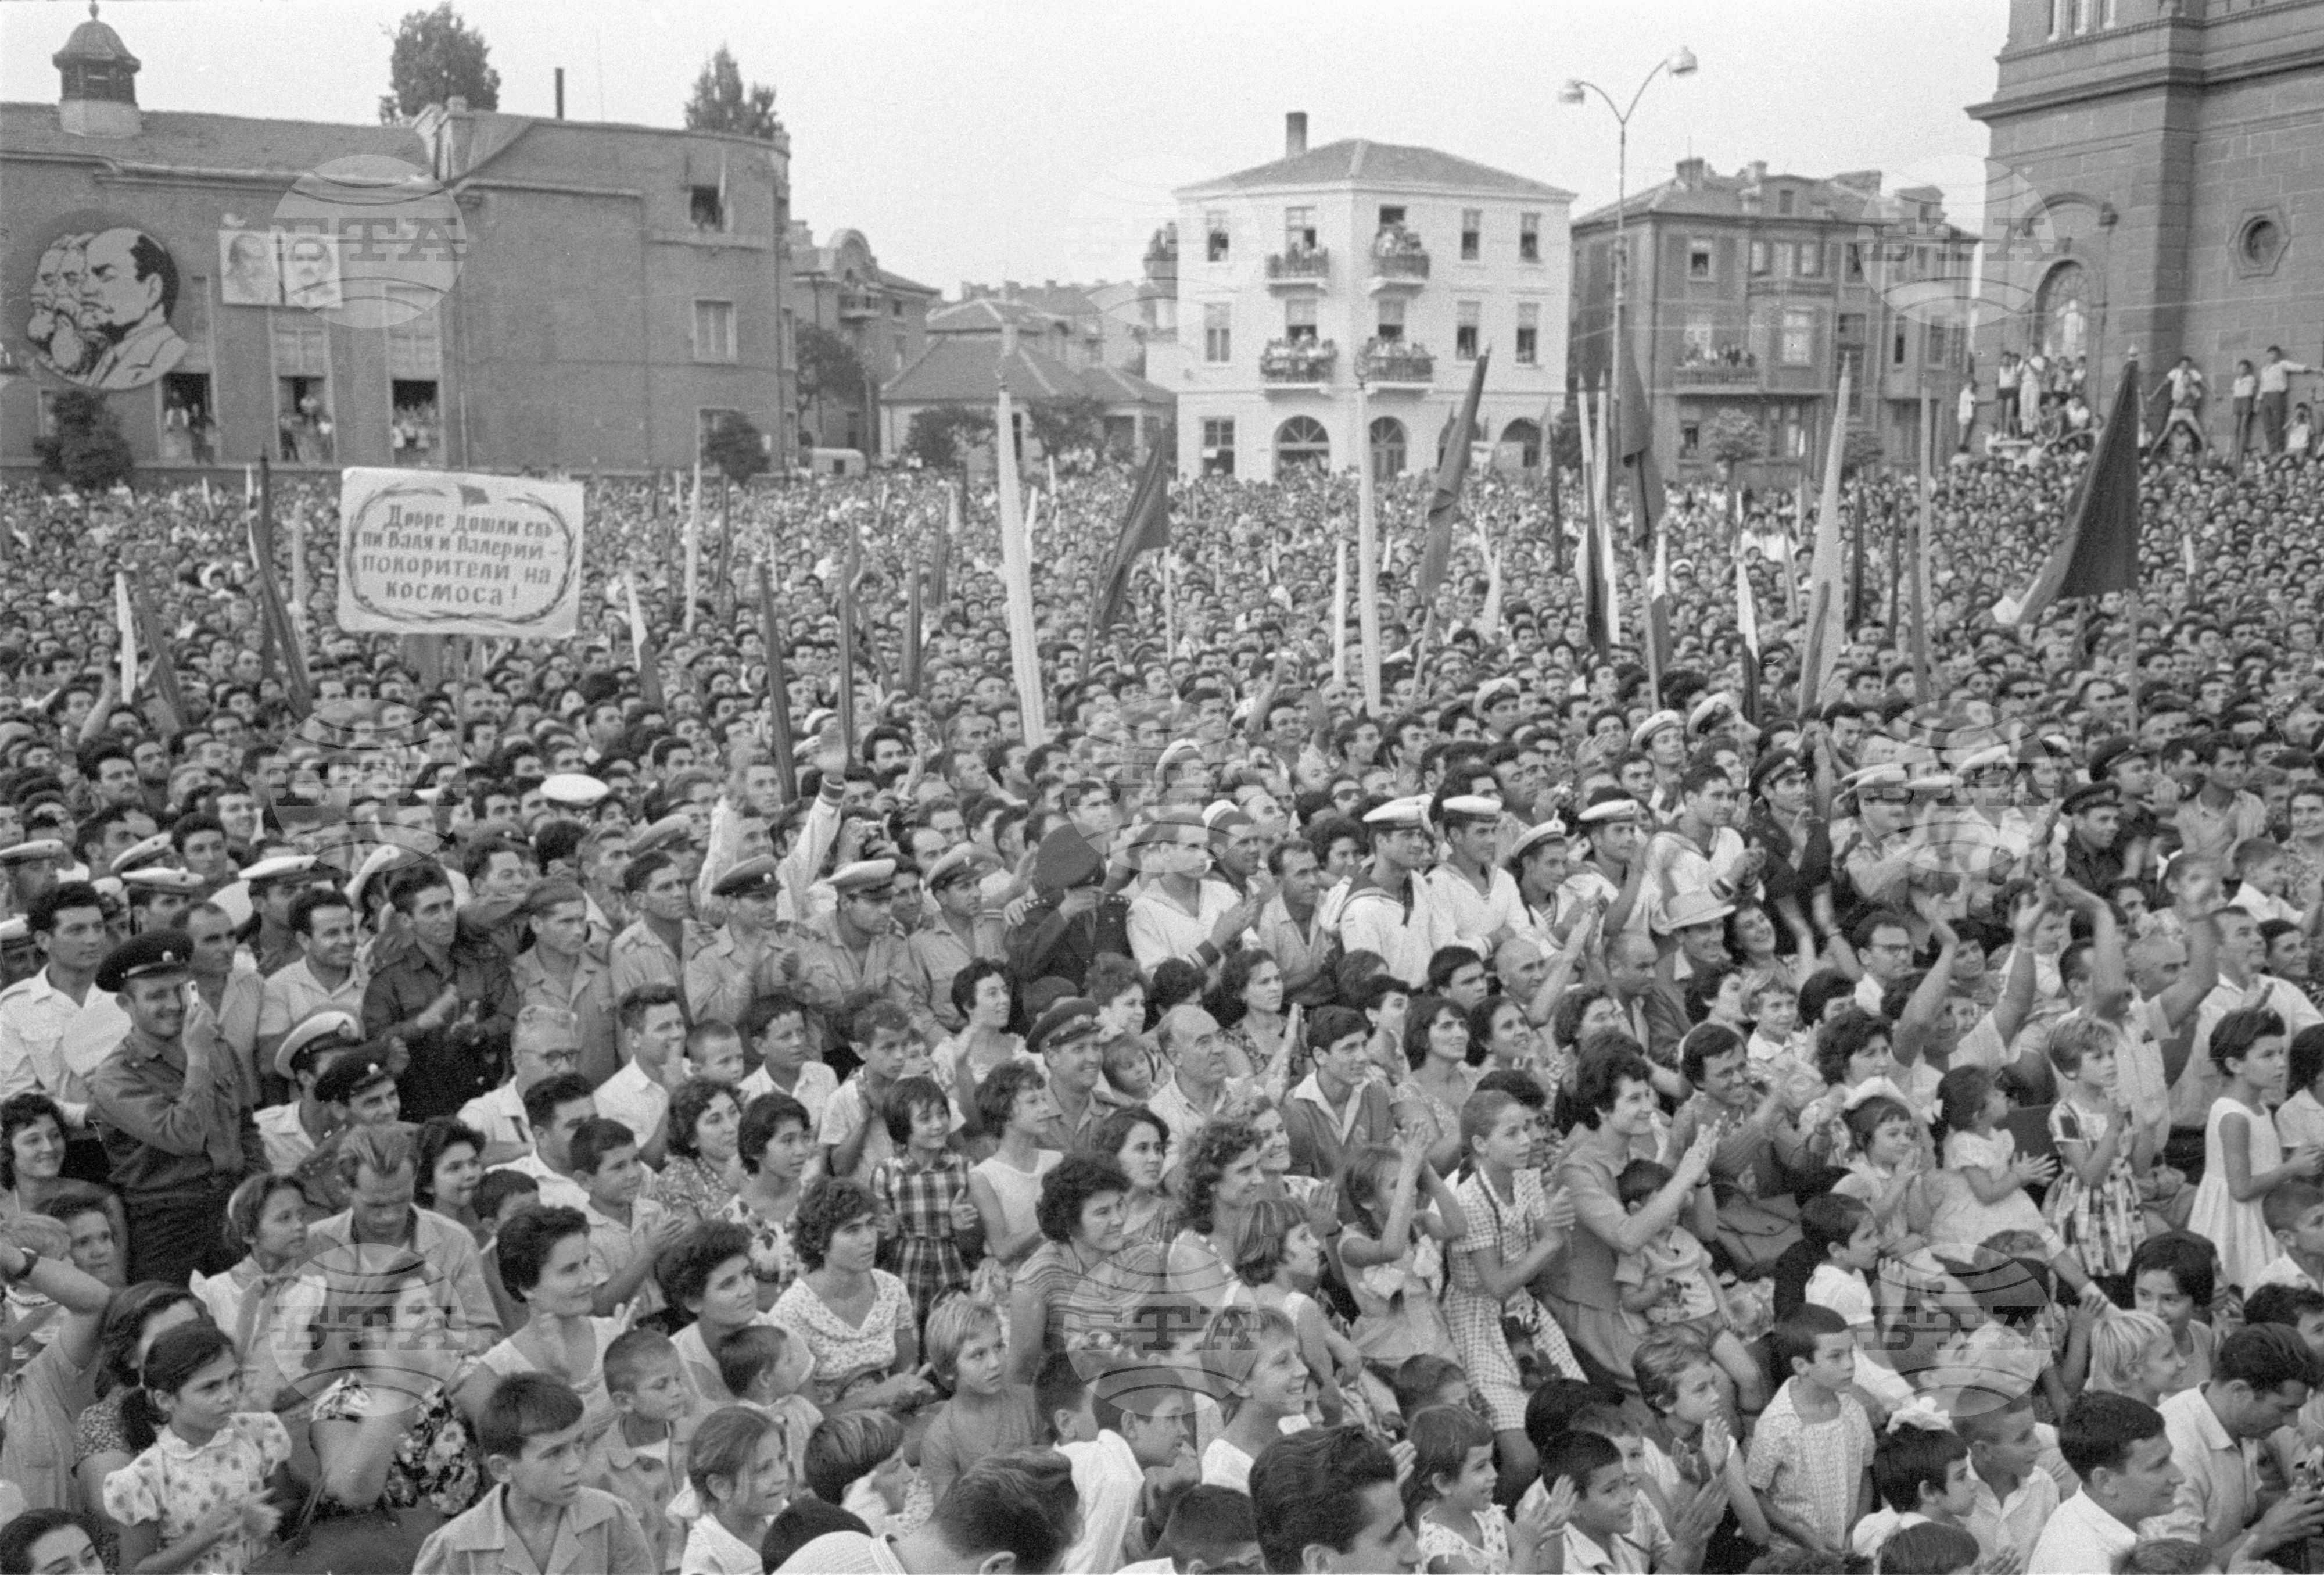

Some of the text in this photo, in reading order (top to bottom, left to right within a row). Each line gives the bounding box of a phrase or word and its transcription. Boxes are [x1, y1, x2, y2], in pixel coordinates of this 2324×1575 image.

[383, 505, 445, 532] Добре
[451, 514, 518, 535] дошли
[362, 531, 383, 547] пи
[388, 531, 433, 550] Валя
[440, 536, 450, 551] и
[361, 555, 551, 585] покорители на
